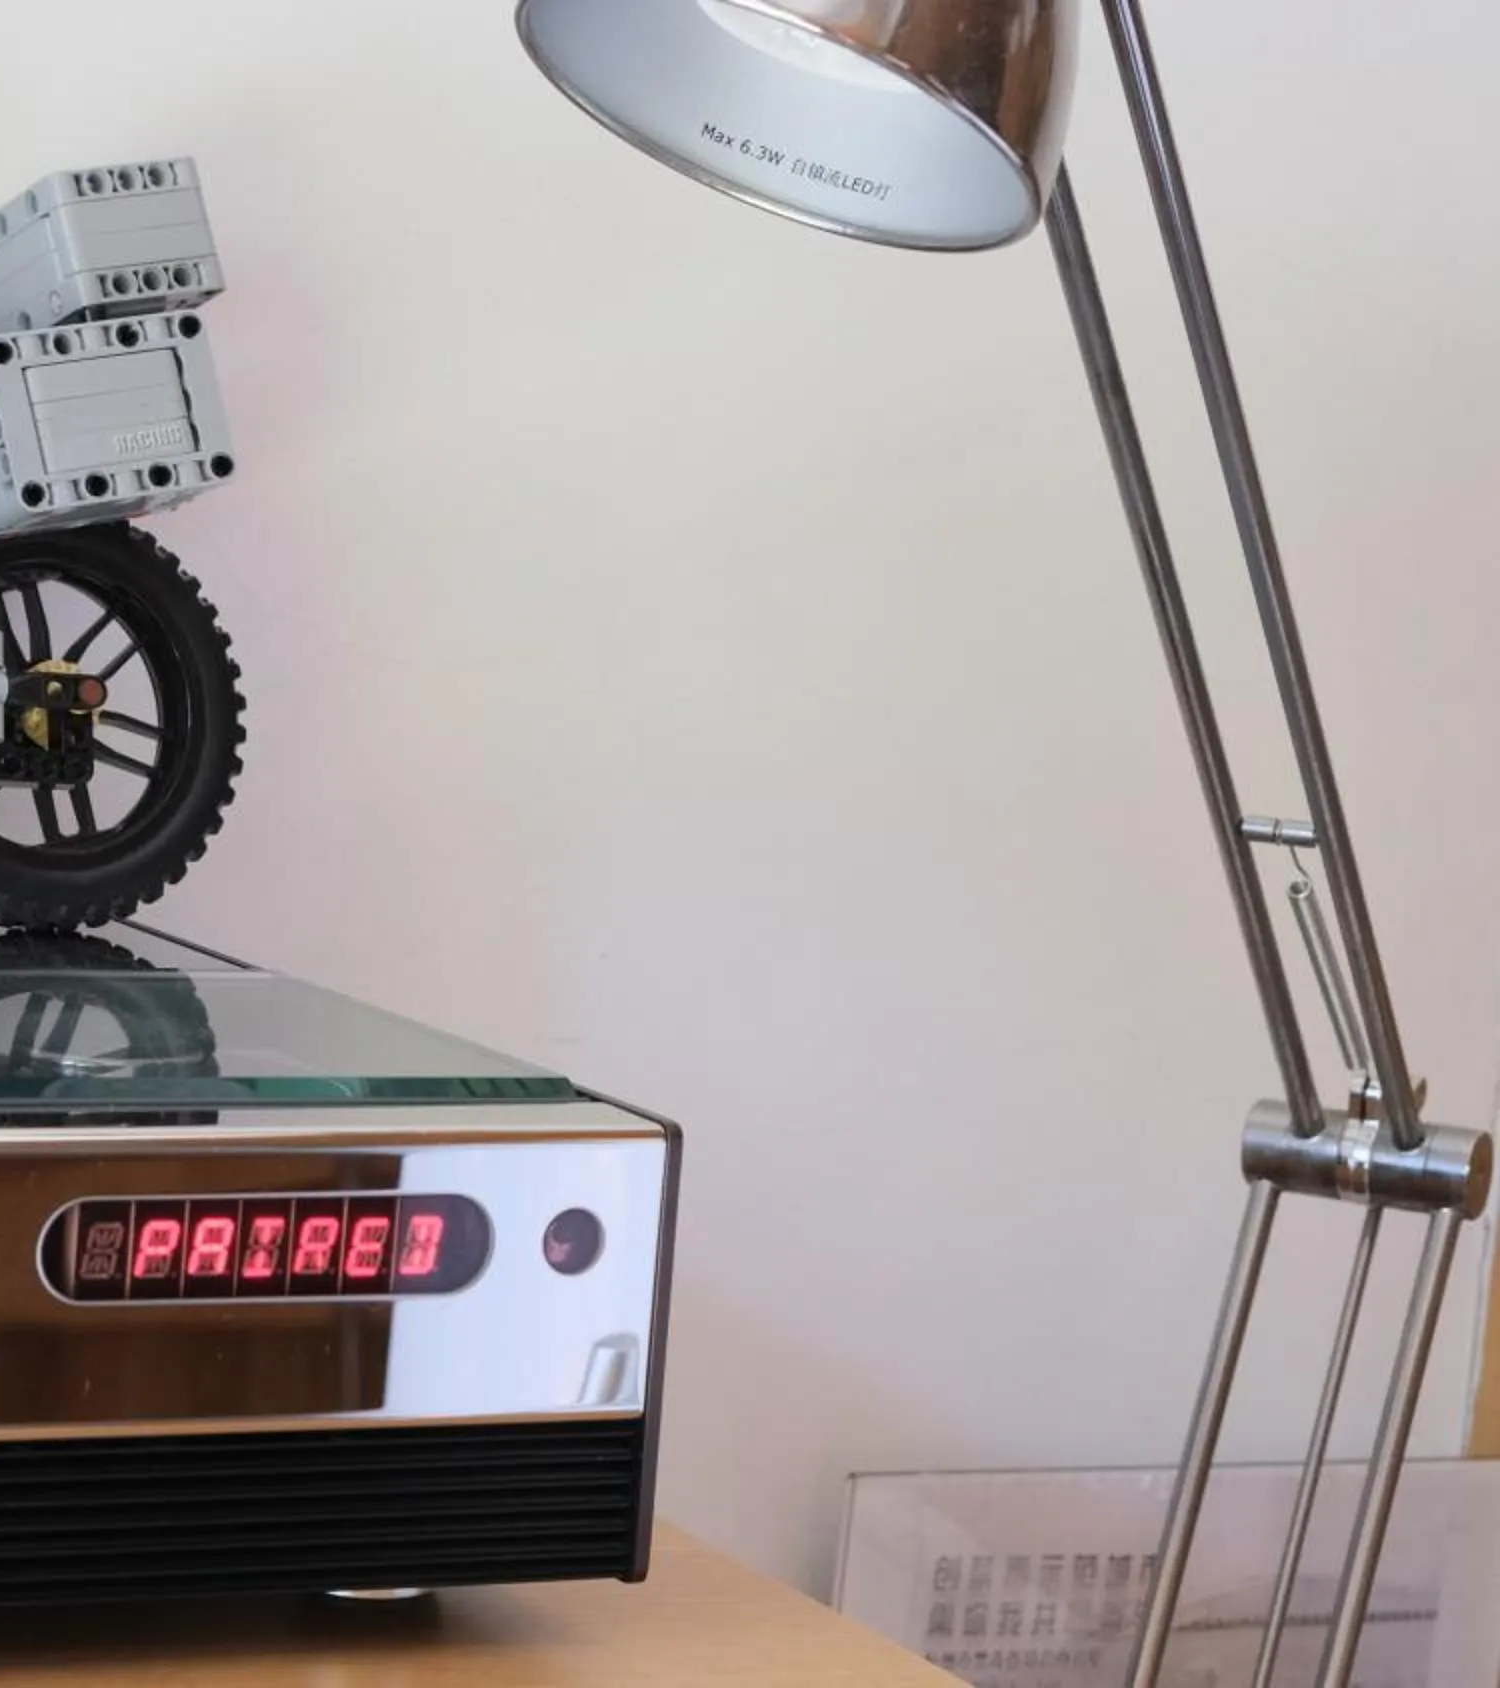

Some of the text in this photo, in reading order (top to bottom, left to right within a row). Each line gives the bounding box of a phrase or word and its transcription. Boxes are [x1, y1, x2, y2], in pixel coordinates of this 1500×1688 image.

[701, 122, 735, 149] Max
[739, 139, 786, 167] 6.3W
[132, 1214, 444, 1278] PAIRED
